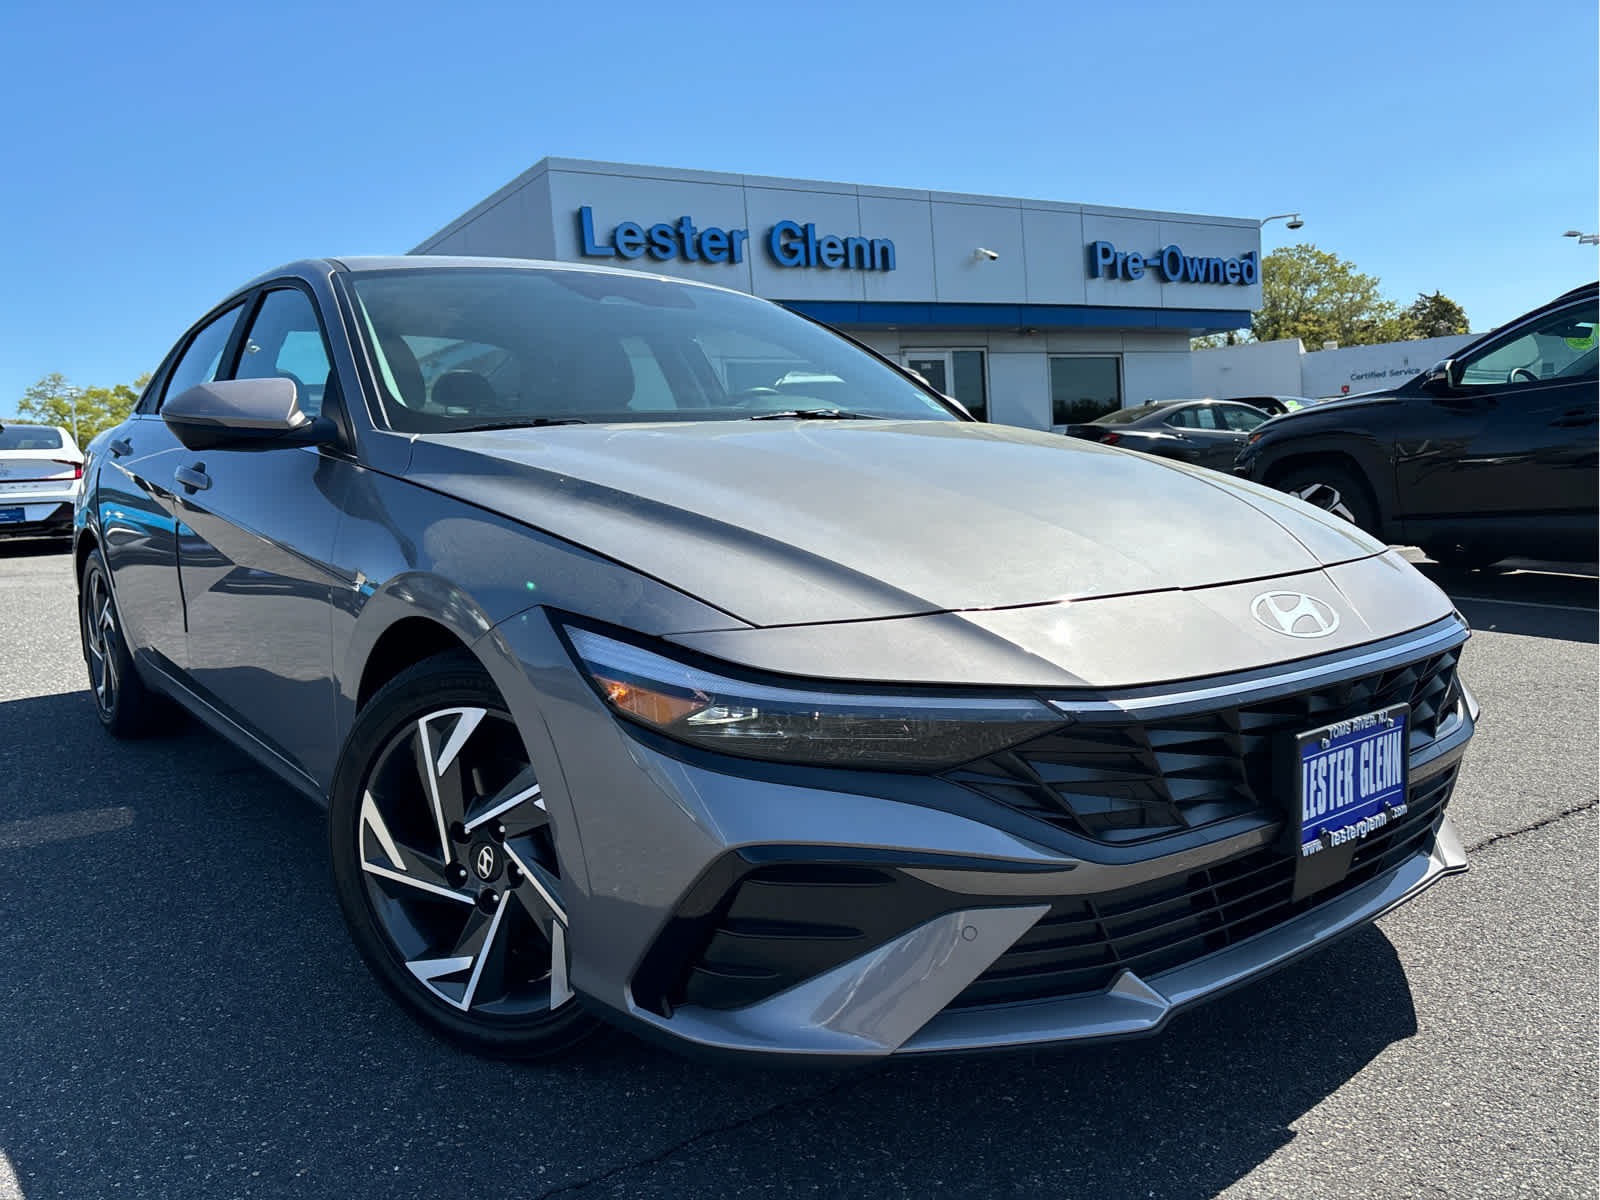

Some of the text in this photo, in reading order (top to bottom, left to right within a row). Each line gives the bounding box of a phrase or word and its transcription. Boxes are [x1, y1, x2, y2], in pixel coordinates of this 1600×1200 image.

[578, 206, 896, 271] Lester Glenn
[1091, 240, 1258, 285] Pre-Owned
[1350, 368, 1421, 380] Certified Service
[1328, 722, 1351, 739] TOMS
[1302, 730, 1402, 822] LESTER GLENN
